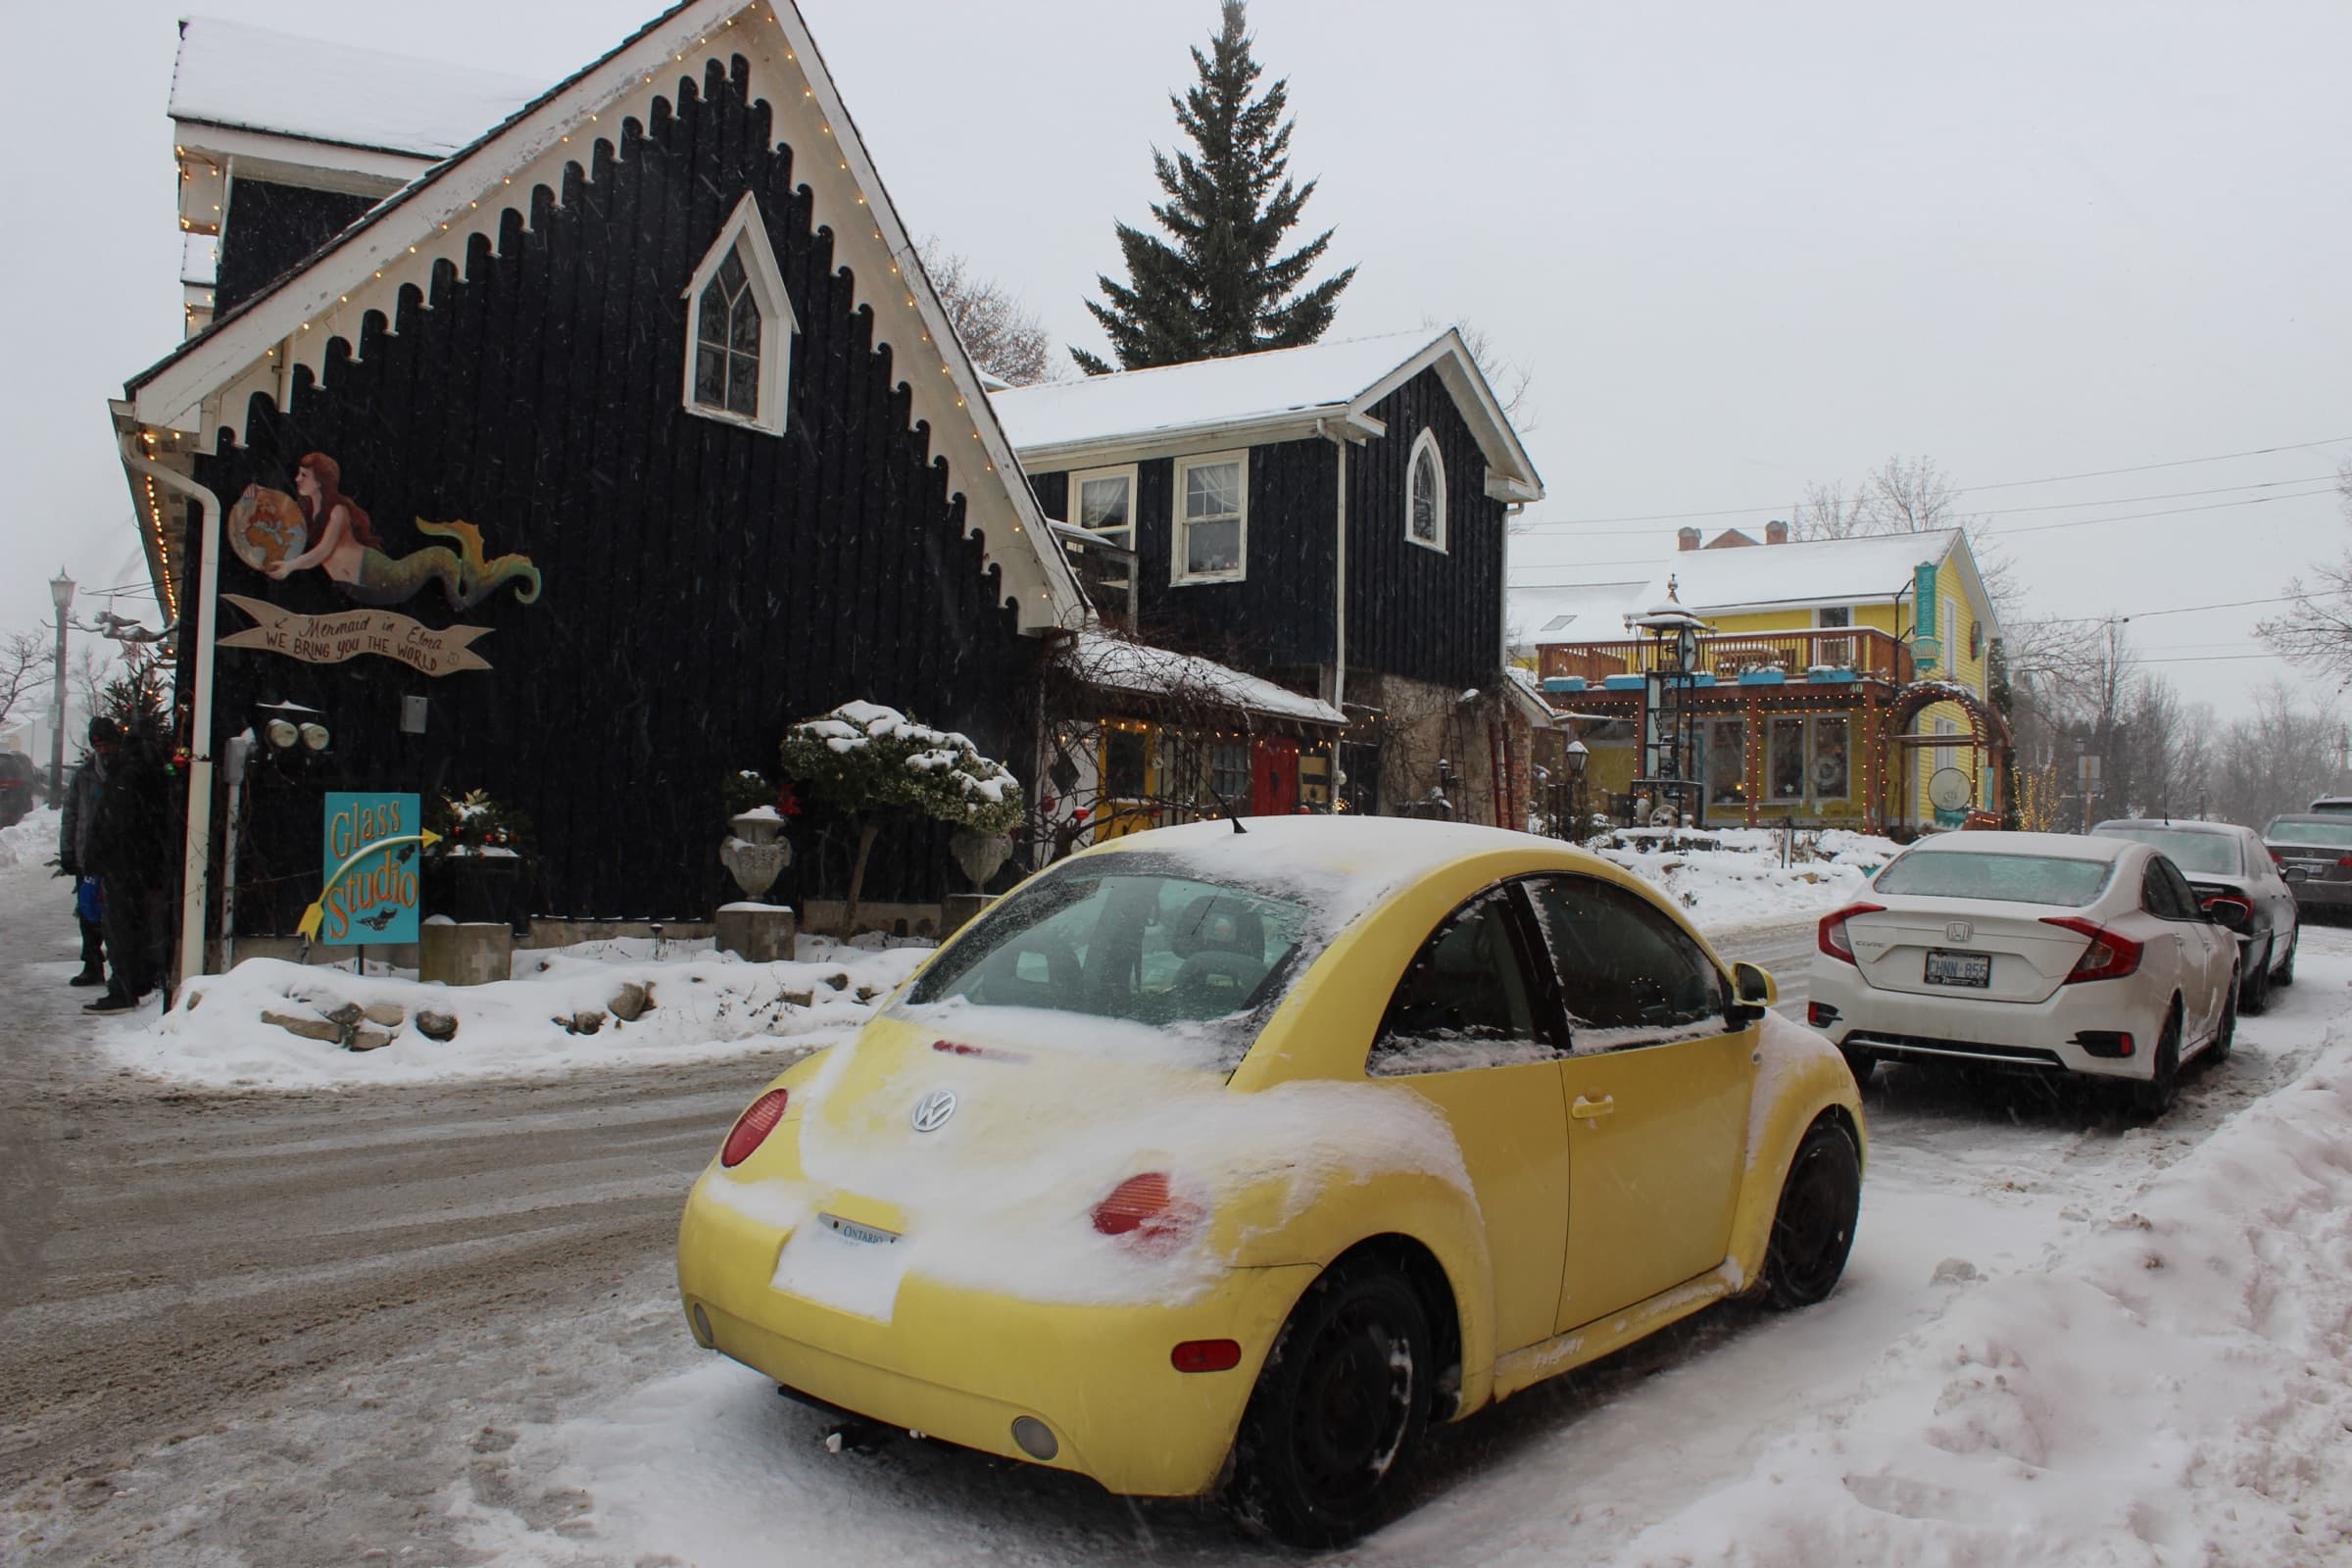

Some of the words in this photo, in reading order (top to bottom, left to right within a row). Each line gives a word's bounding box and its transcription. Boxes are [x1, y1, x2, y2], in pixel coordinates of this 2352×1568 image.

[267, 631, 288, 649] WE
[294, 638, 330, 662] BRING
[368, 635, 390, 654] THE
[397, 643, 437, 671] WORLD
[298, 615, 370, 639] Mermaid
[382, 616, 396, 633] in
[407, 626, 443, 651] Elora
[1850, 683, 1863, 694] 40
[330, 800, 402, 859] Glass
[327, 850, 418, 940] Studio
